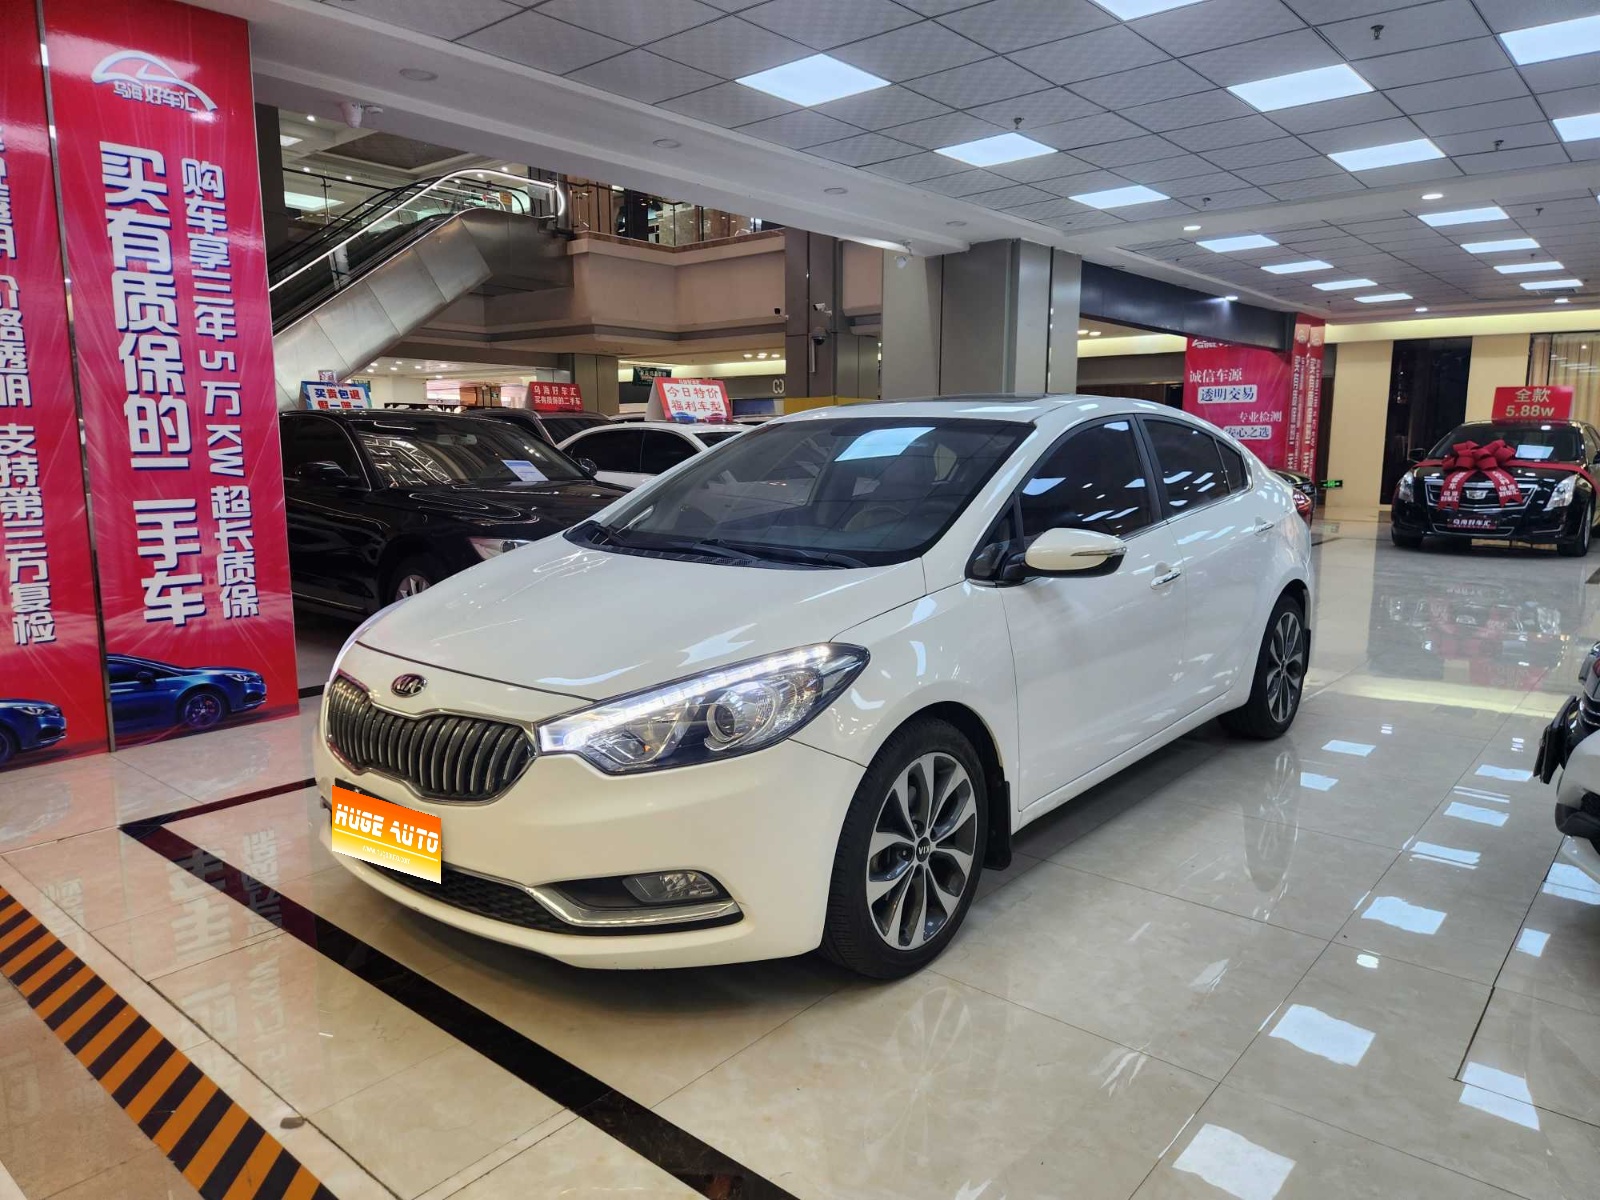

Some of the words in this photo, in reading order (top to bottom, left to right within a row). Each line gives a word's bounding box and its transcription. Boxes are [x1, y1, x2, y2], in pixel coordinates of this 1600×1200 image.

[113, 81, 197, 112] 乌海好车汇
[1190, 367, 1242, 383] 诚信车源
[100, 141, 207, 626] 买有质保的二手车
[667, 386, 719, 399] 今日特价
[1201, 387, 1254, 402] 透明交易
[1514, 388, 1551, 402] 全款
[671, 400, 724, 412] 福利车型
[1239, 411, 1282, 423] 专业检测
